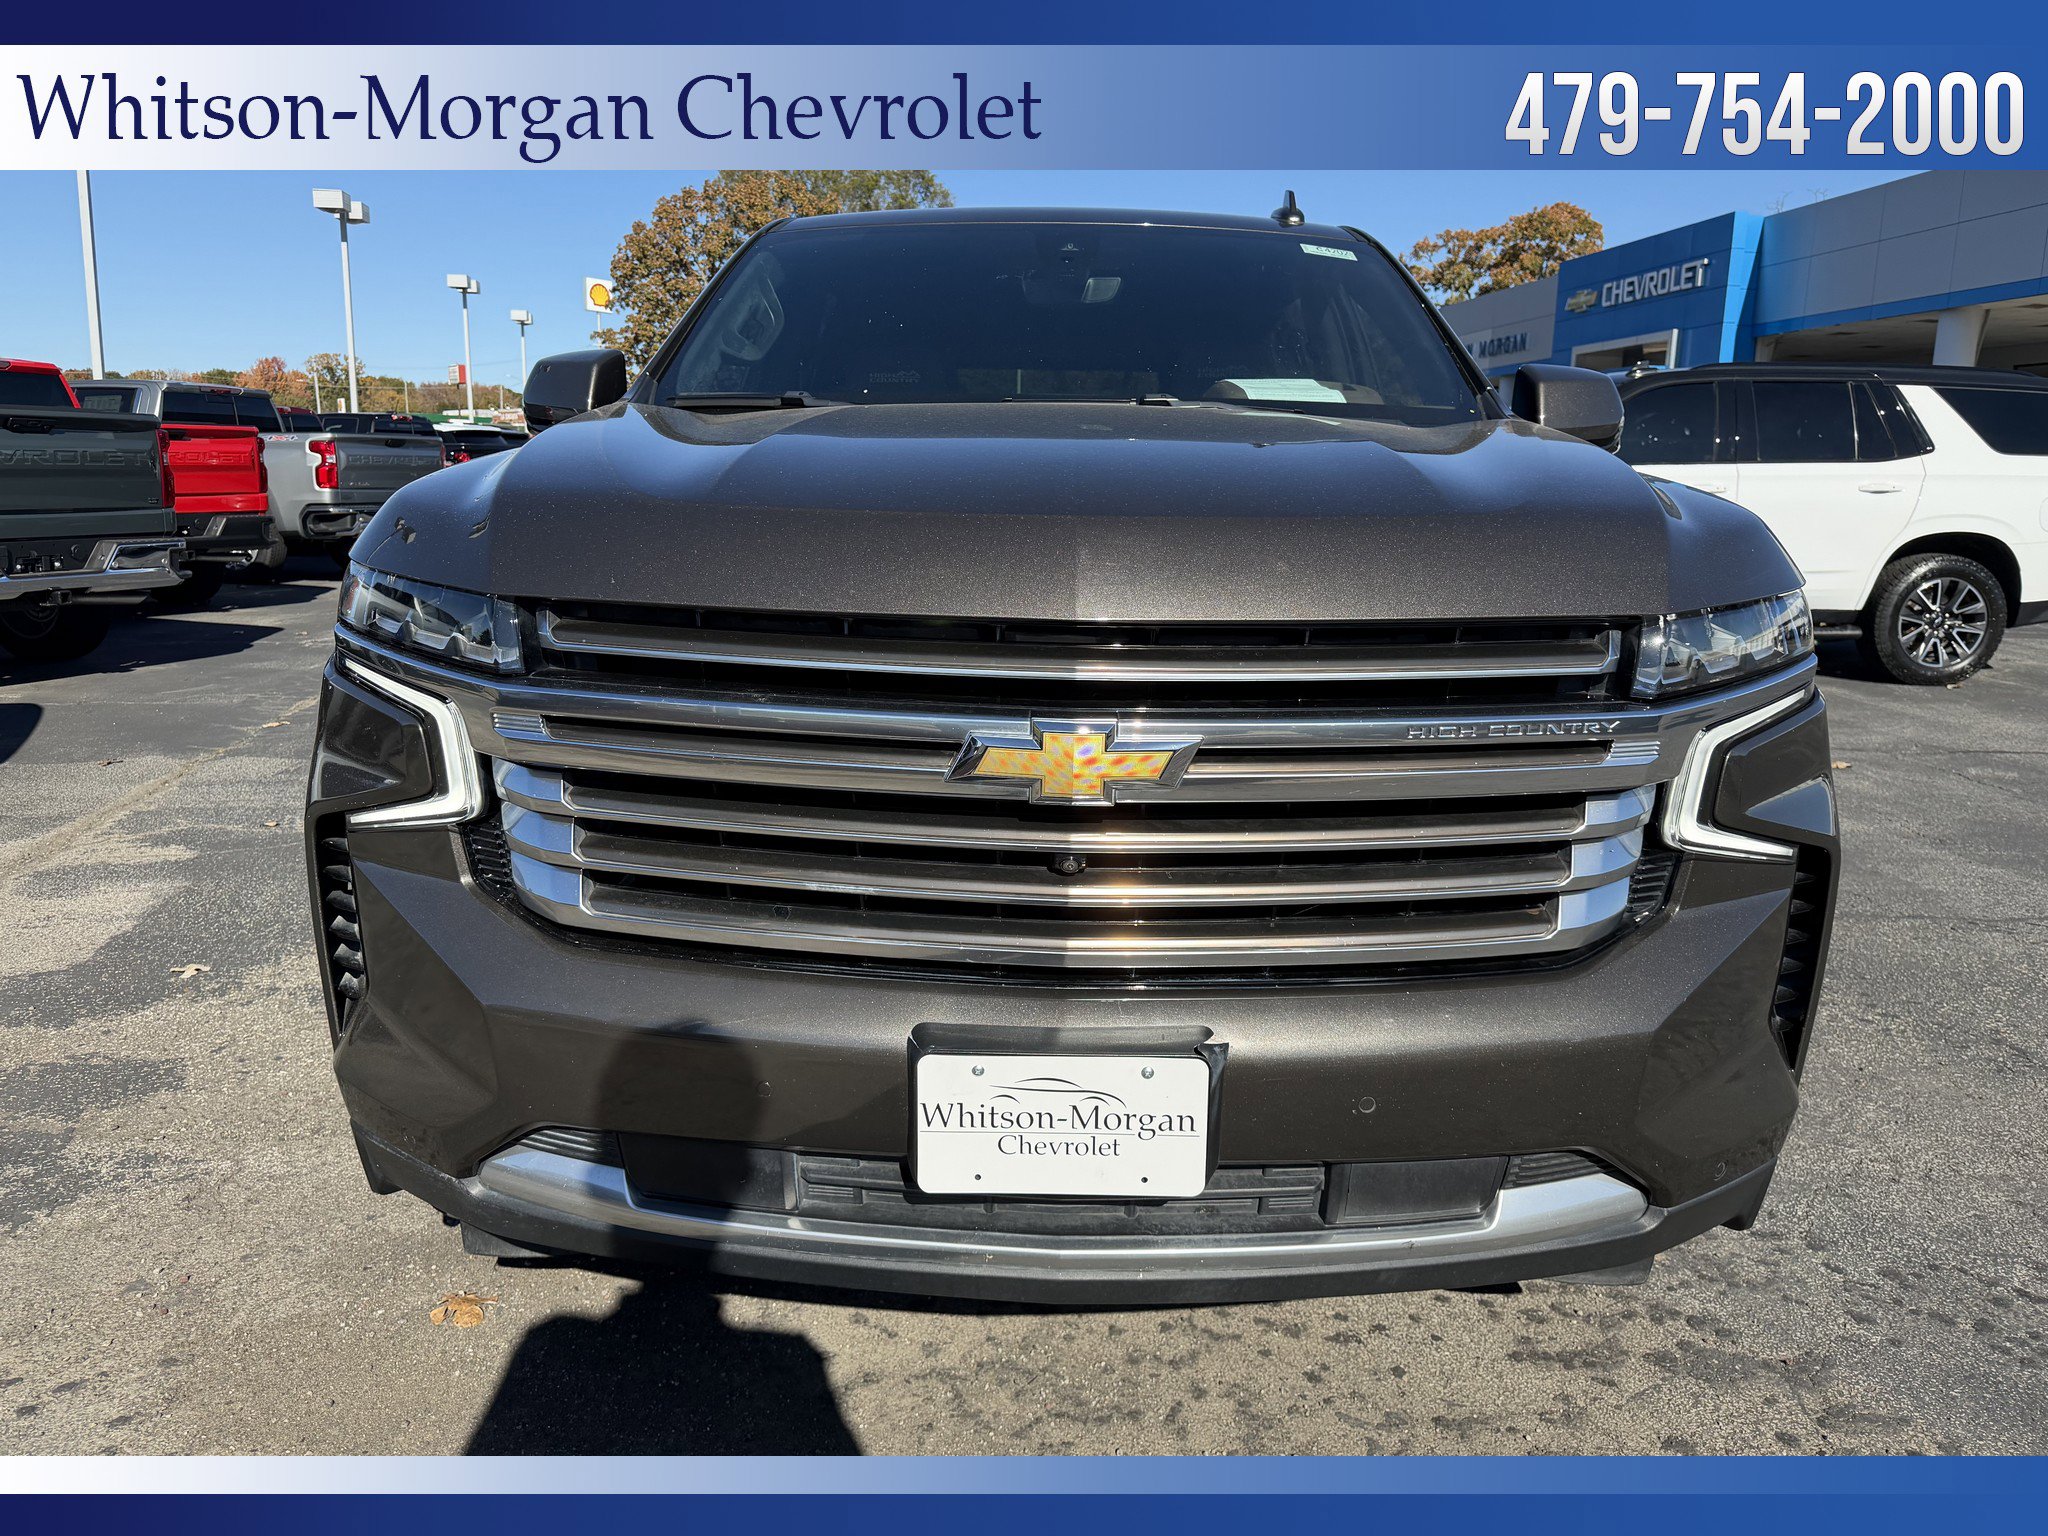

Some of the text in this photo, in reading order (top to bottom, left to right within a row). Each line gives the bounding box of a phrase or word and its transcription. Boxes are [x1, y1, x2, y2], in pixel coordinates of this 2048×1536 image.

[1601, 258, 1710, 307] CHEVROLET
[1479, 332, 1528, 358] MORGAN
[1407, 720, 1621, 739] HIGH COUNTRY
[919, 1102, 1197, 1140] Whitson-Morgan
[997, 1134, 1121, 1157] Chevrolet
